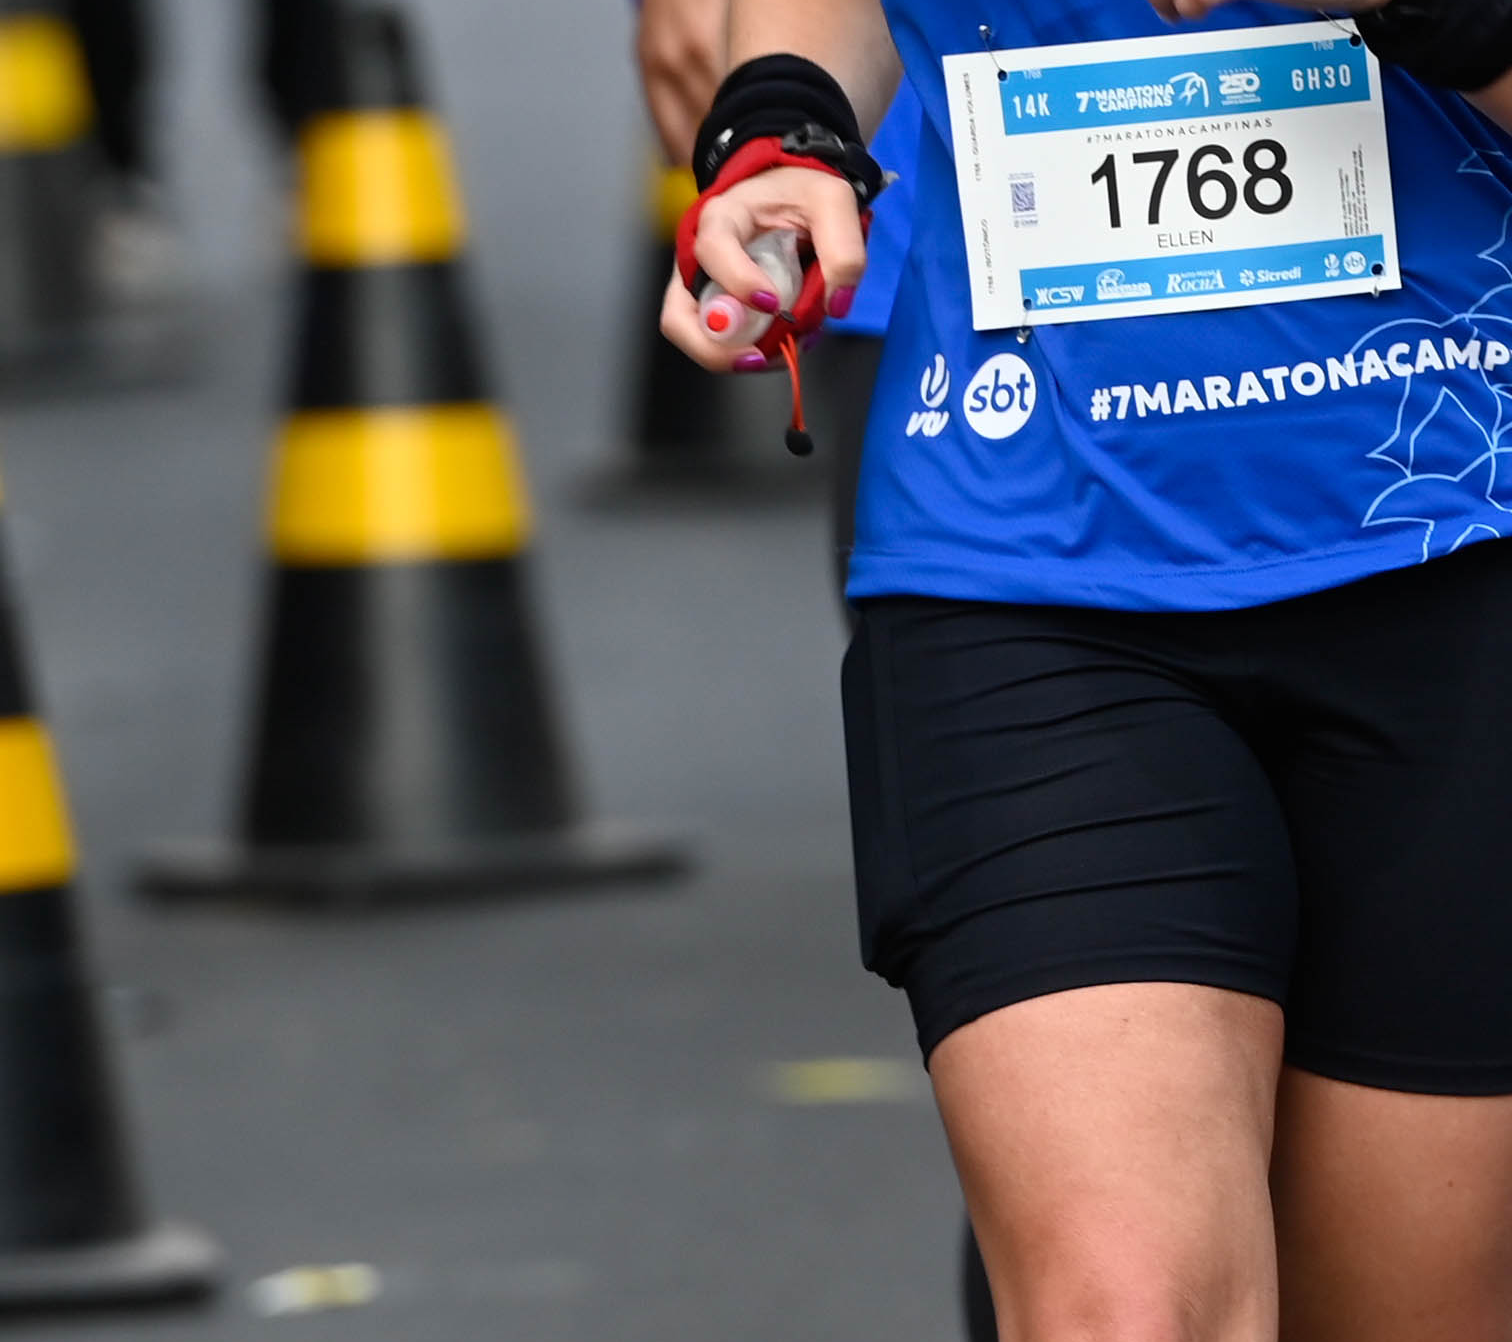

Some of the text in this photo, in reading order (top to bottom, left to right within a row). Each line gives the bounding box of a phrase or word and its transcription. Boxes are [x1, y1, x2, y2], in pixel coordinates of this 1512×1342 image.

[1290, 63, 1352, 92] 6H30
[1013, 92, 1051, 119] 14K
[1094, 83, 1176, 102] MARATONA
[1097, 94, 1174, 113] CAMPINAS
[1086, 117, 1274, 145] #7MARATONACAMPINAS
[1090, 138, 1294, 229] 1768
[1157, 228, 1215, 249] ELLEN
[1256, 266, 1303, 284] Sicredi
[968, 368, 1031, 413] sbt
